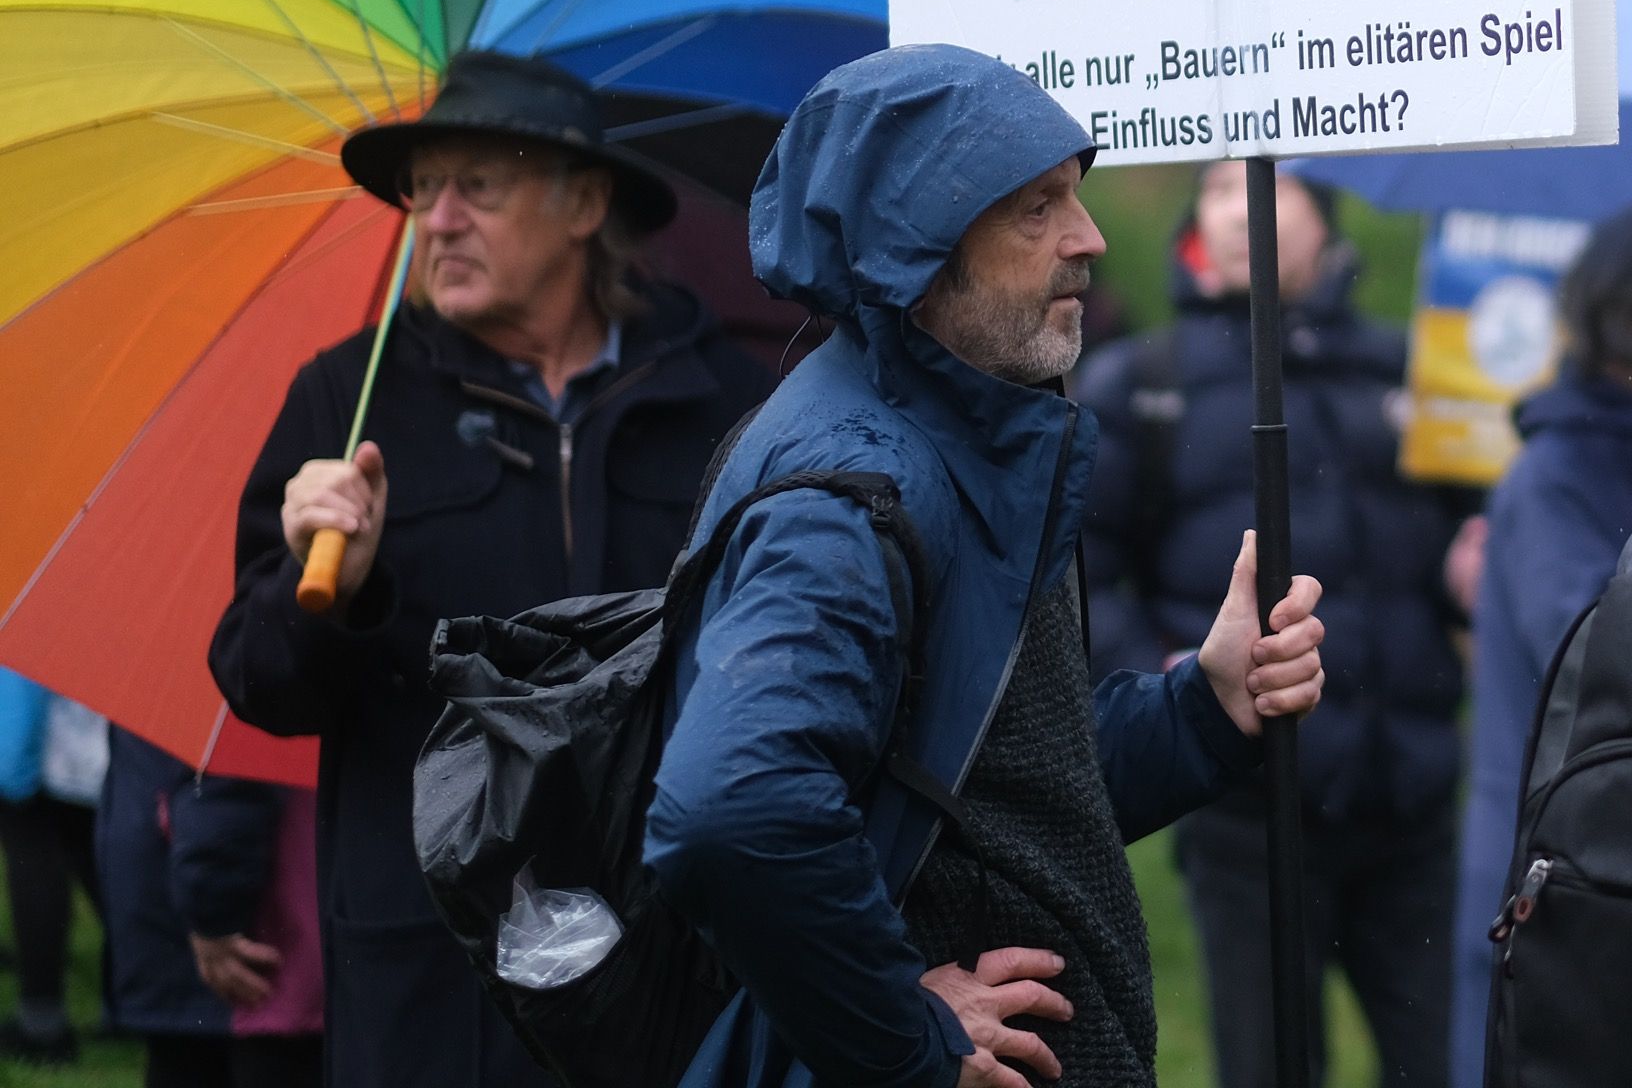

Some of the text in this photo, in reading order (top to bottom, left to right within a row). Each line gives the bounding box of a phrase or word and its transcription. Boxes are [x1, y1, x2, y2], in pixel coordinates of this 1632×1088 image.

[1085, 56, 1134, 88] nur
[1297, 31, 1334, 69] im
[1346, 22, 1468, 67] elitären
[1480, 9, 1563, 65] Spiel
[1091, 89, 1410, 151] Einfluss und Macht?
